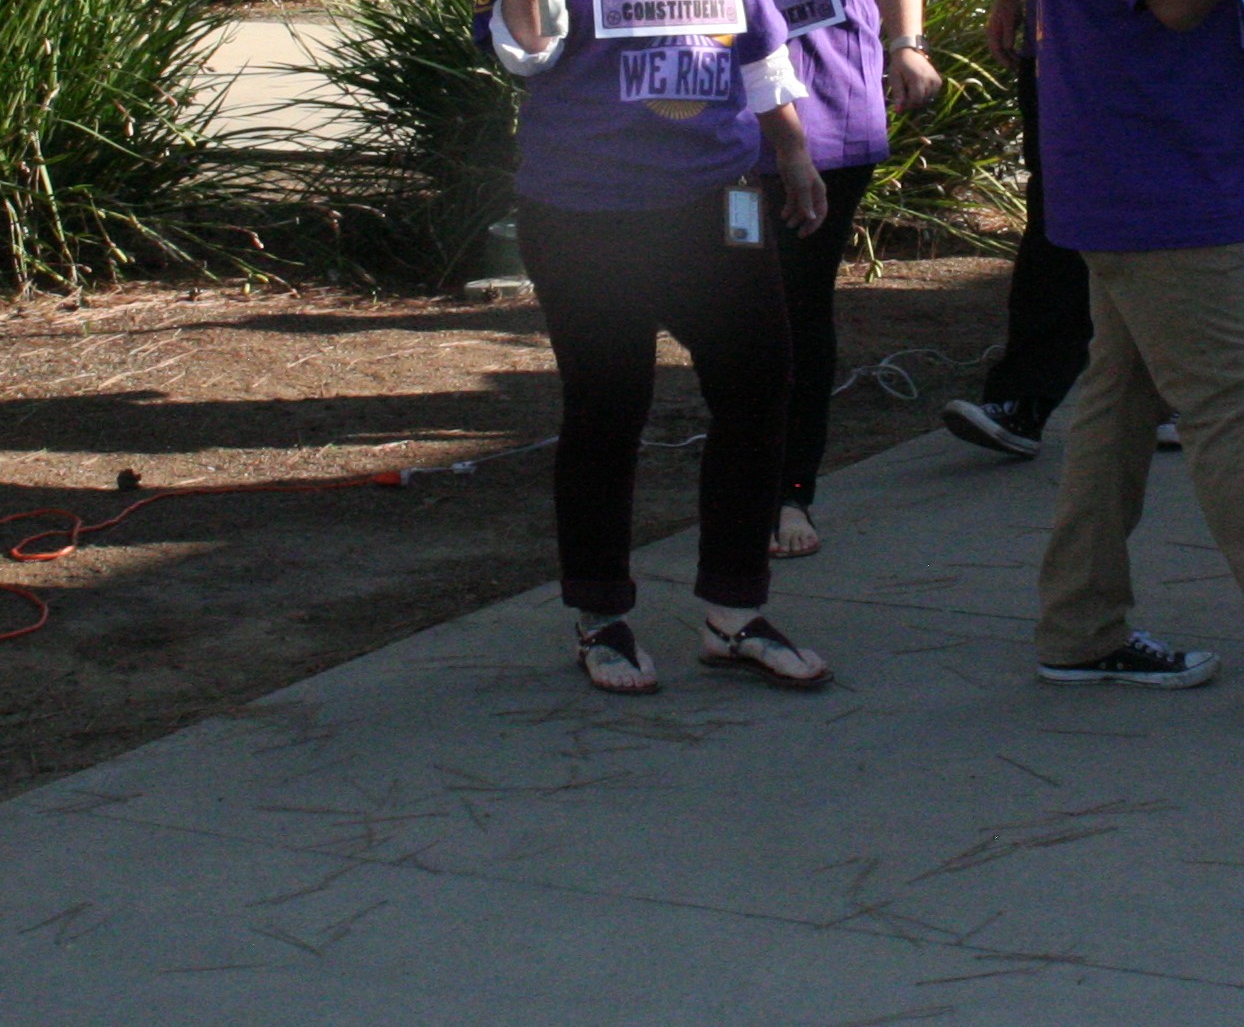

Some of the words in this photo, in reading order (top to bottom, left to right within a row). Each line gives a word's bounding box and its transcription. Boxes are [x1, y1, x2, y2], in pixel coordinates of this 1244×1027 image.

[621, 0, 726, 22] CONSTITUENT
[622, 51, 667, 98] WE
[675, 49, 730, 97] RISE
